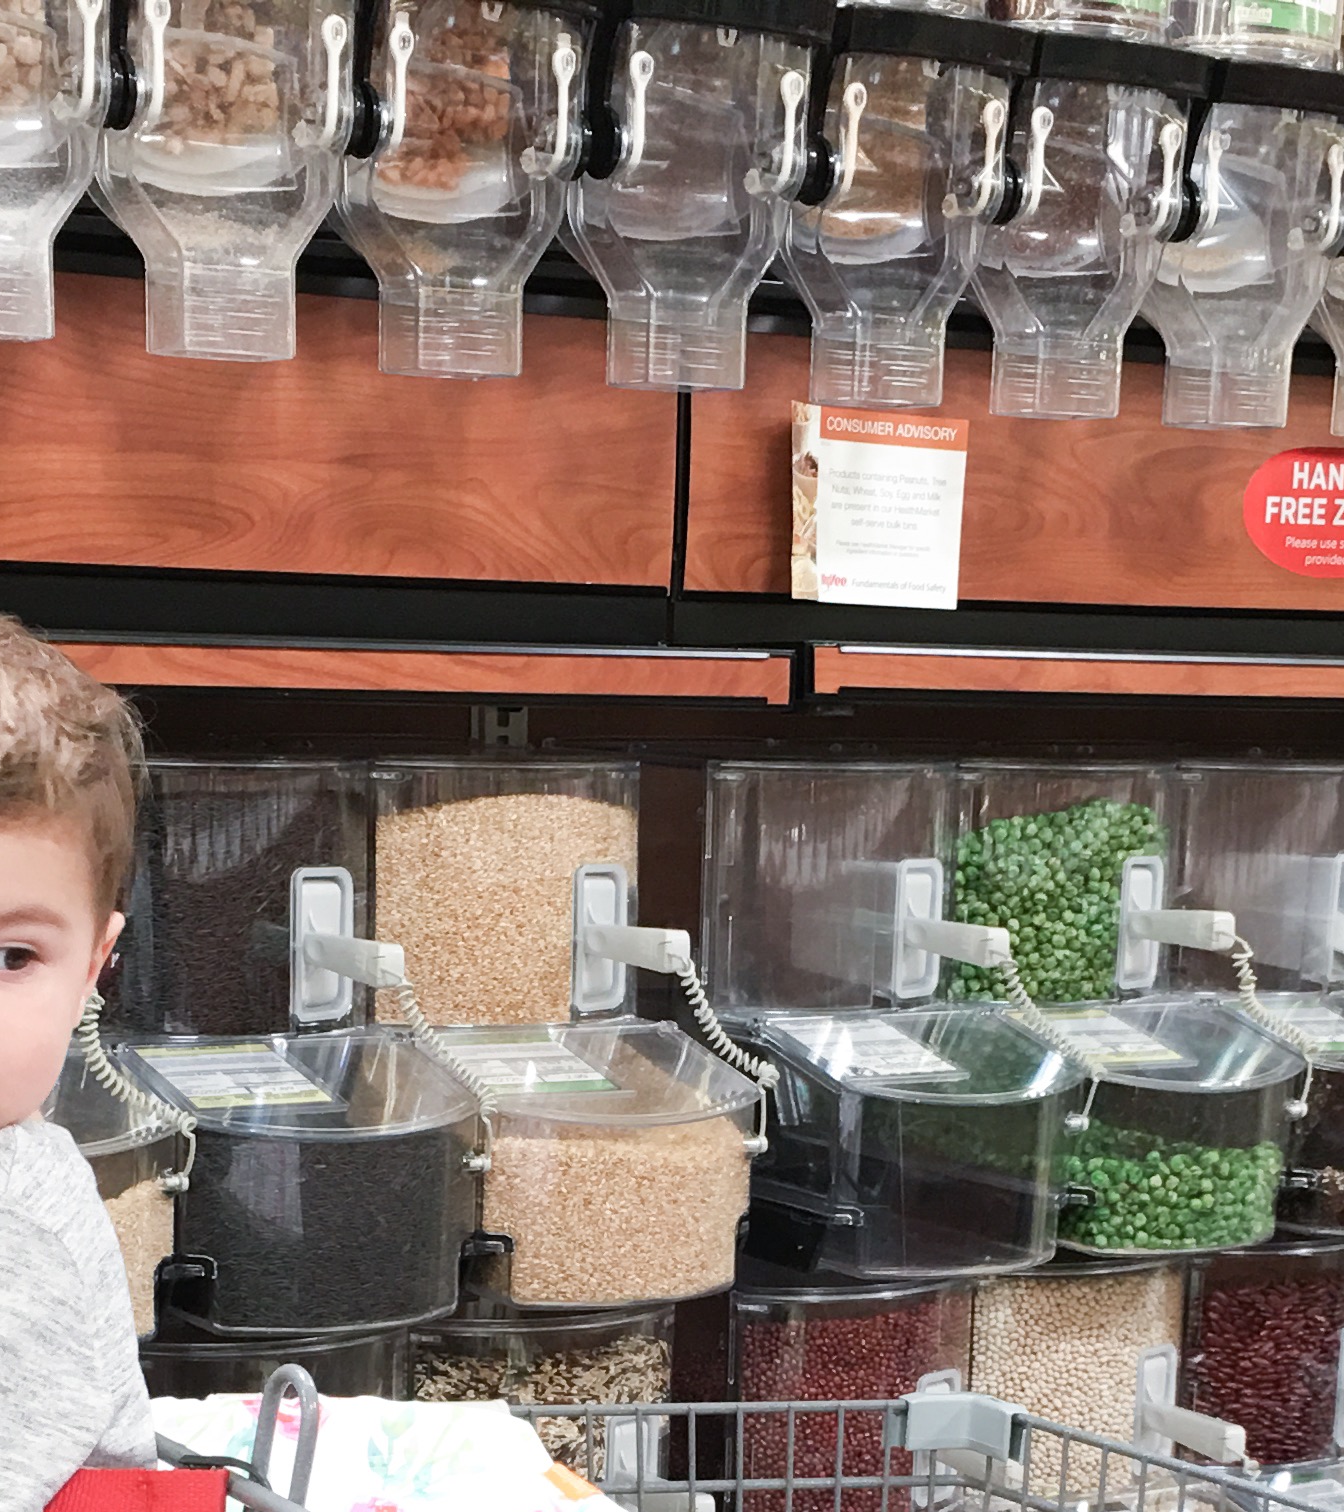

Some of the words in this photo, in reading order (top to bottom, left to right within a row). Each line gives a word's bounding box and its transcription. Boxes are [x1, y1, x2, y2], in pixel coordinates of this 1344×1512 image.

[826, 416, 894, 437] CONSUMER
[895, 424, 958, 442] ADVISORY
[829, 468, 860, 480] Products
[896, 489, 910, 502] Egg
[912, 489, 925, 500] and
[1265, 496, 1328, 525] FREE
[1285, 536, 1317, 549] Please
[1320, 539, 1337, 550] use
[852, 579, 899, 590] Fundamentals
